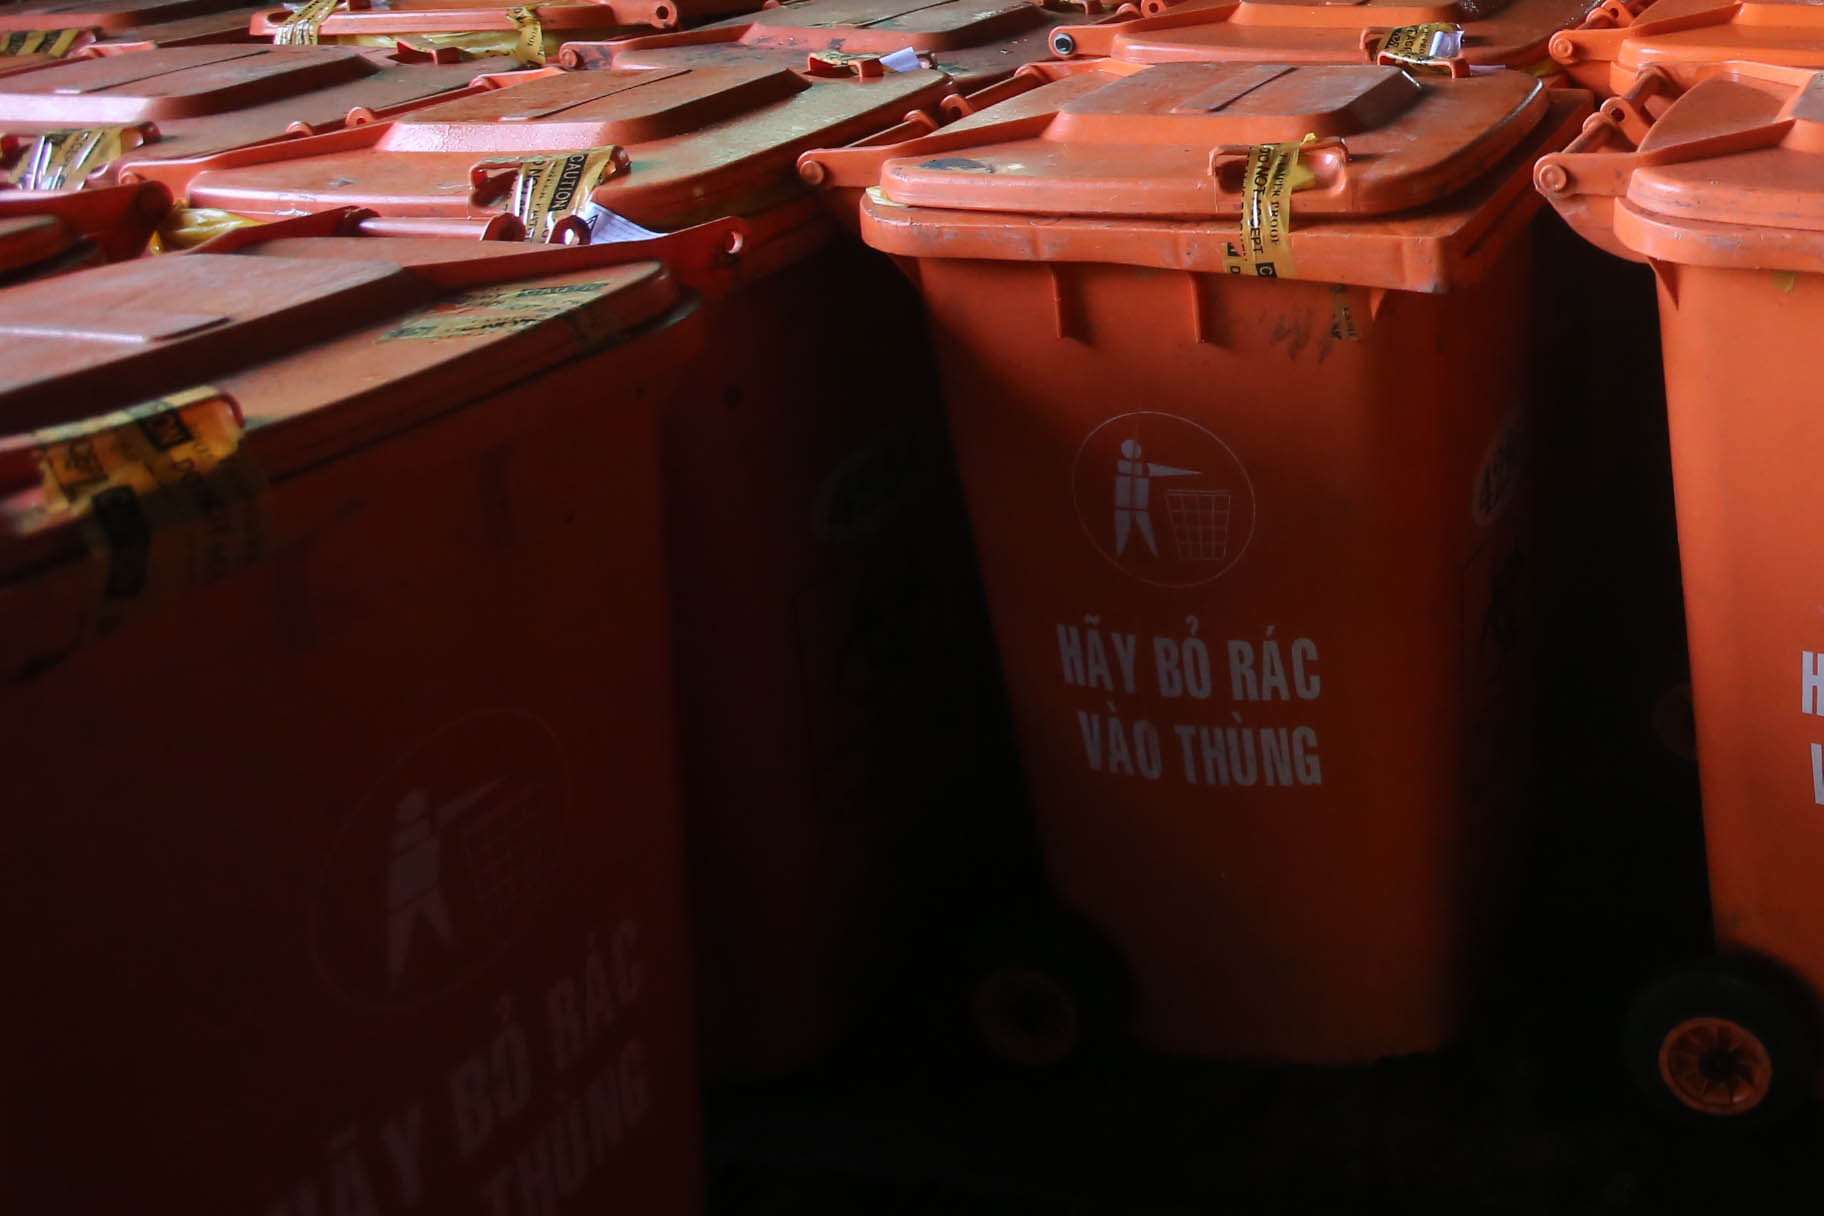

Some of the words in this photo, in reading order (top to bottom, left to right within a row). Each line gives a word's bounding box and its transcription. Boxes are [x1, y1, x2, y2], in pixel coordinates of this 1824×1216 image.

[552, 155, 586, 210] CAUTION
[1255, 166, 1269, 194] NOT
[1056, 612, 1137, 695] HÃY
[1153, 614, 1213, 701] BỎ
[1226, 623, 1322, 702] RÁC
[1077, 699, 1163, 781] VÀO
[1173, 710, 1323, 788] THÙNG
